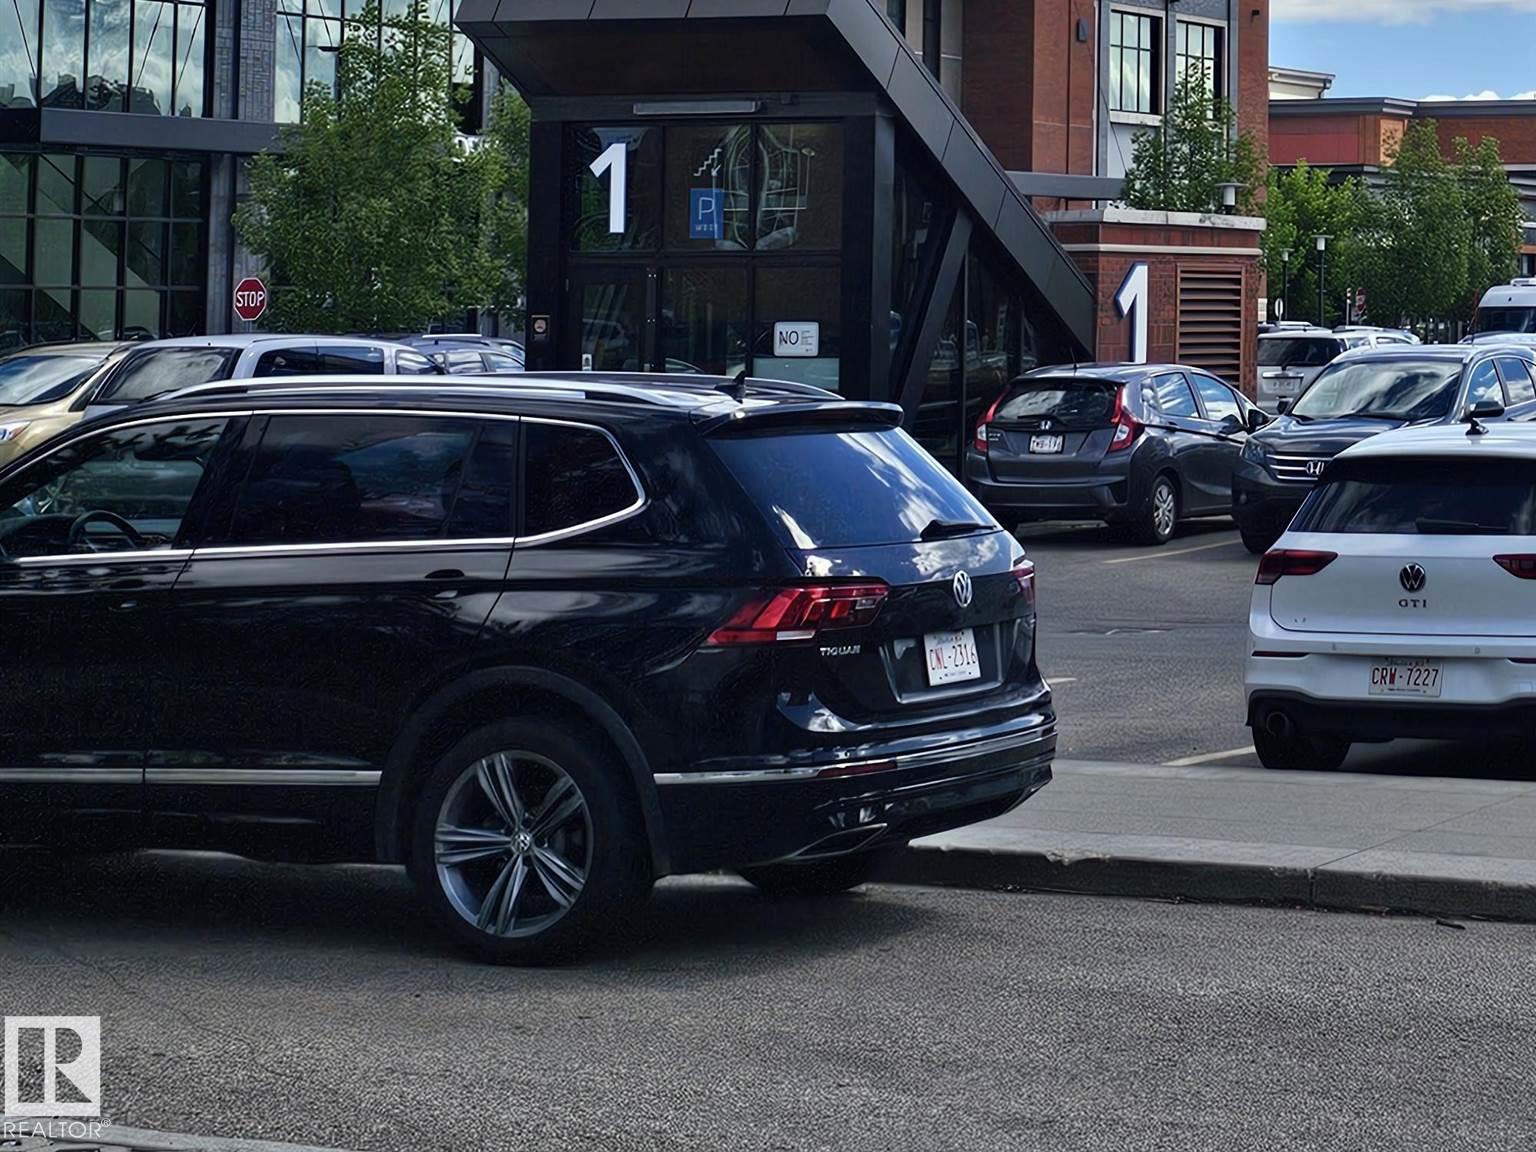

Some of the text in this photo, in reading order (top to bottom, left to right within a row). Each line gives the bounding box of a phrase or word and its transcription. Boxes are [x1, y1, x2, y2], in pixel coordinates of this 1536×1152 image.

[589, 143, 626, 233] 1
[699, 197, 715, 220] P
[236, 291, 265, 307] STOP
[1115, 262, 1148, 364] 1
[1398, 598, 1427, 608] GTI
[1371, 666, 1439, 688] CRW-7227
